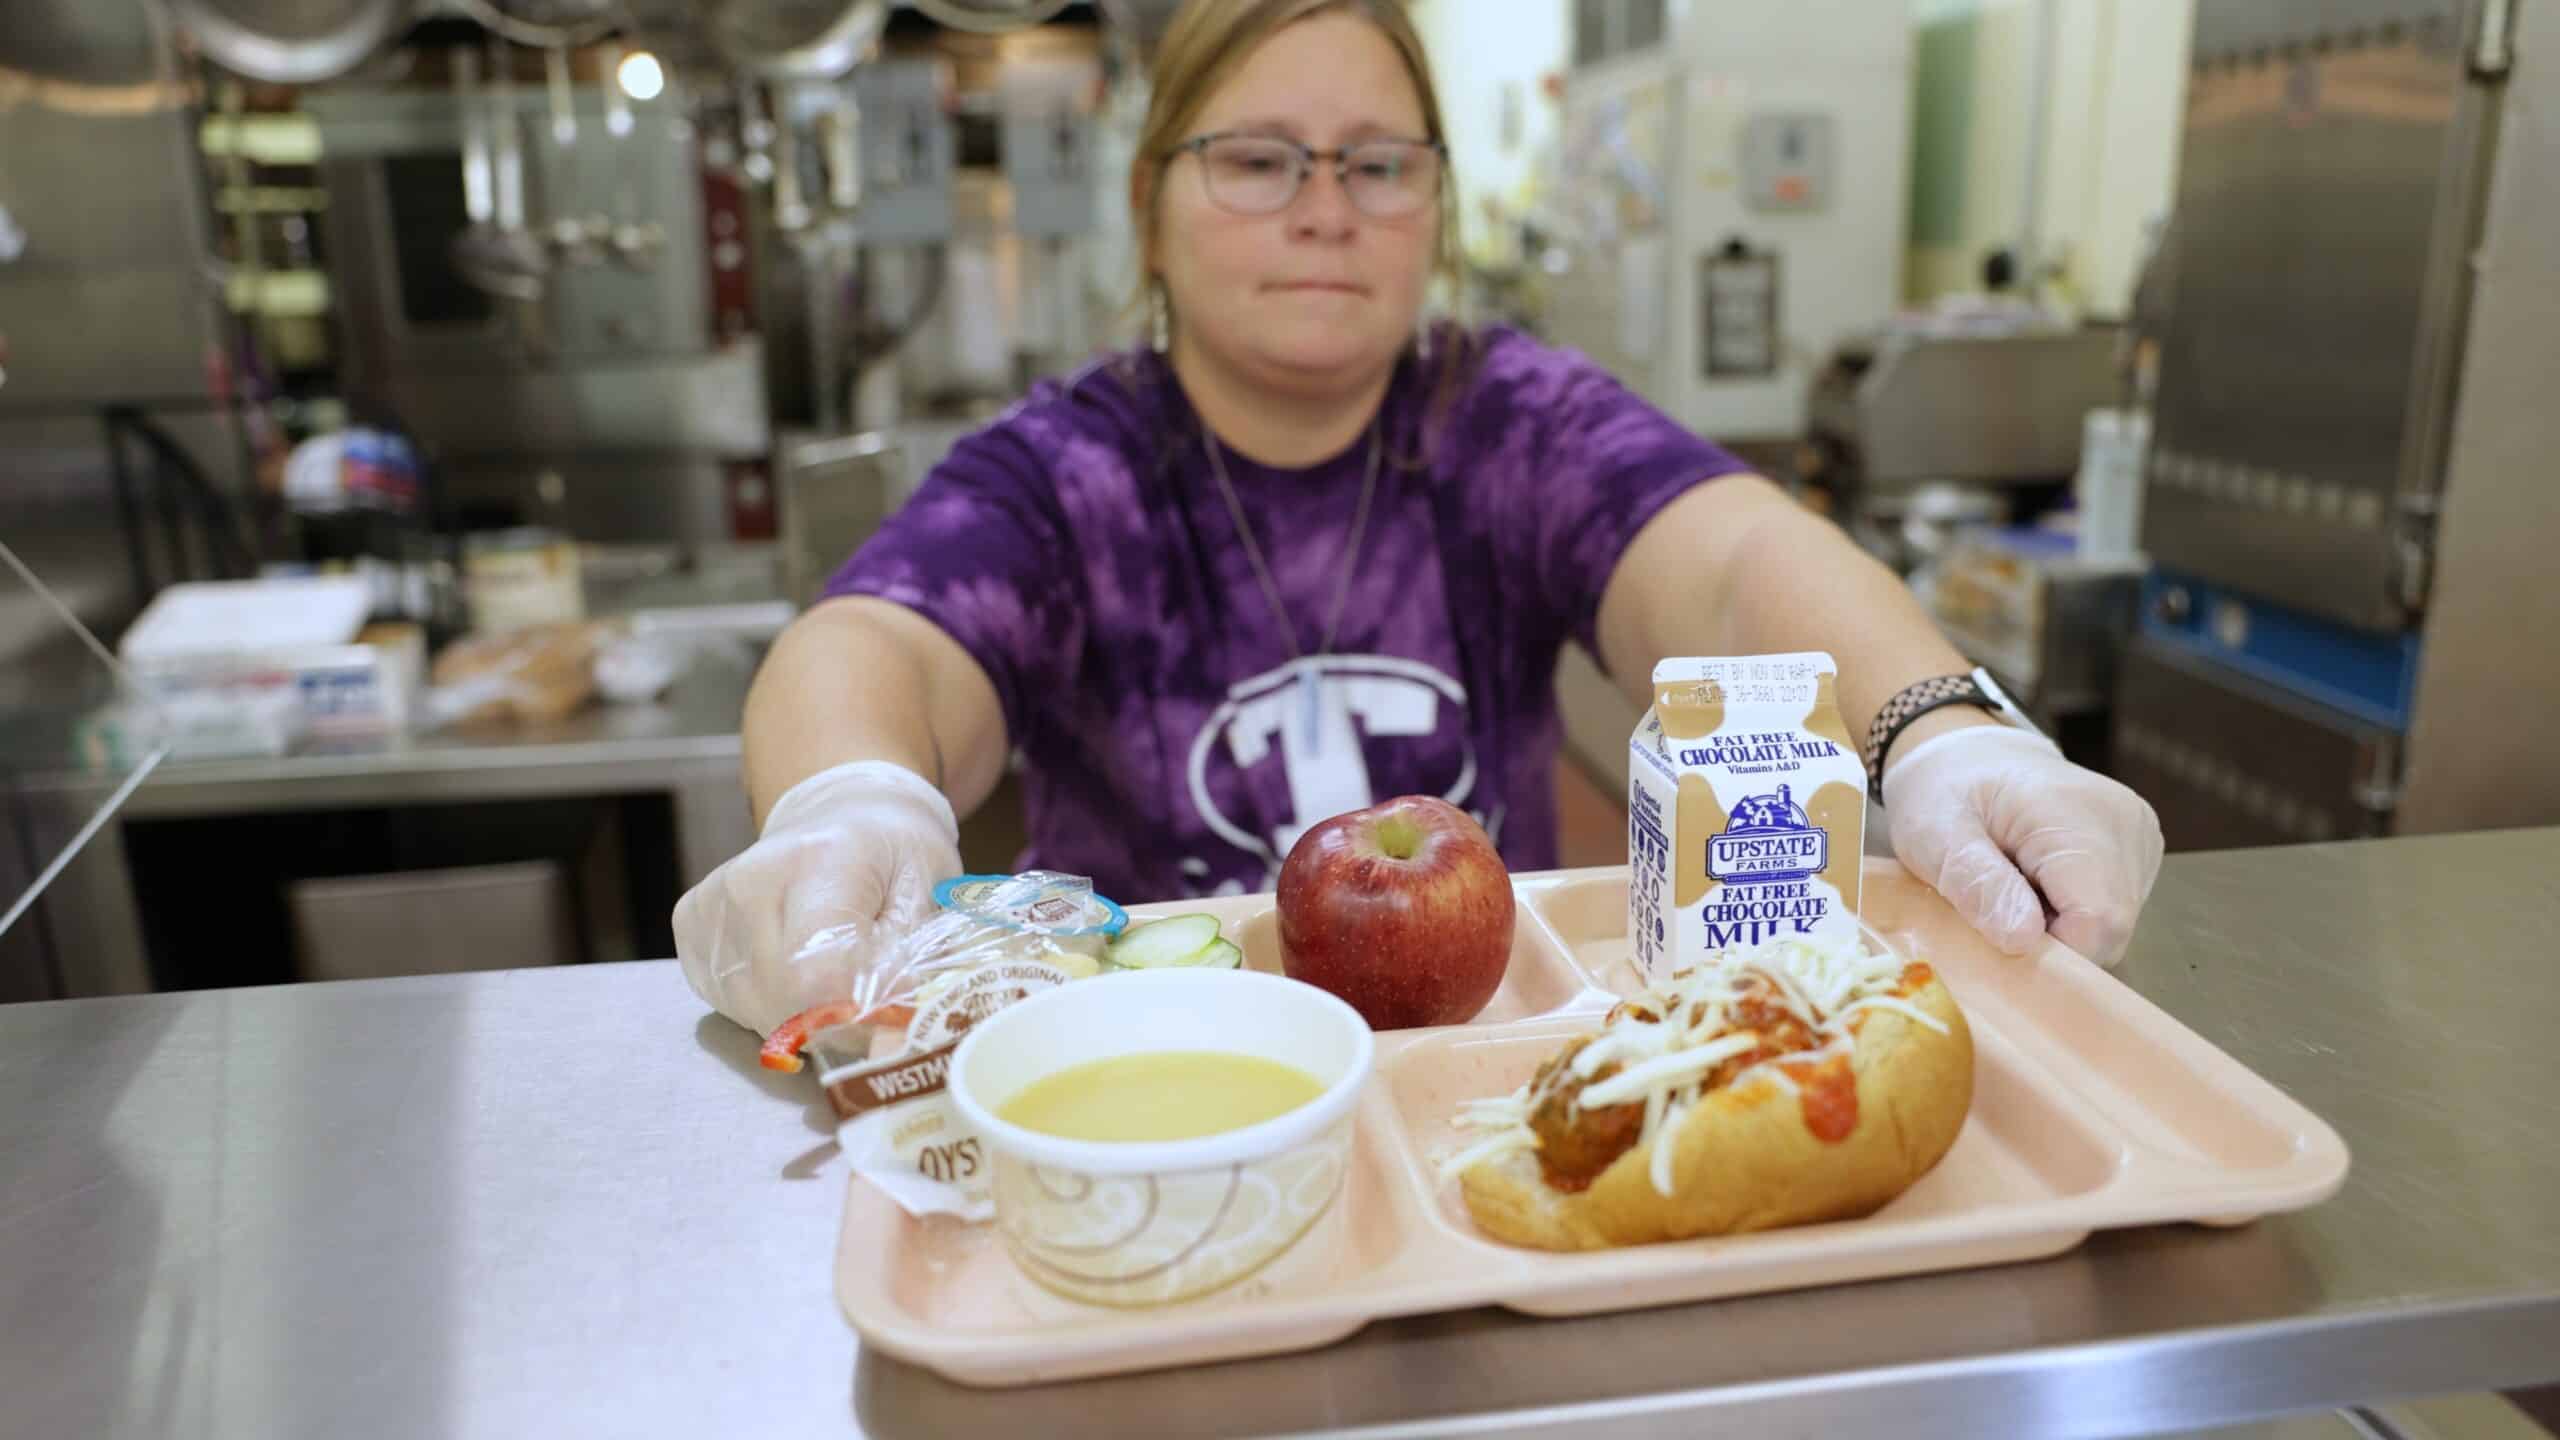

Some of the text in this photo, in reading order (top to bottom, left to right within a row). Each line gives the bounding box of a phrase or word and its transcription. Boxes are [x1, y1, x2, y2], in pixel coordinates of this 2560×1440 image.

[1712, 731, 1798, 747] FAT FREE
[1680, 743, 1787, 766] CHOCOLATE
[1790, 740, 1840, 759] MILK
[1728, 761, 1800, 775] Vitamins A&D
[1718, 836, 1816, 861] UPSTATE
[1736, 859, 1797, 871] FARMS
[1722, 883, 1810, 902] FAT FREE
[1702, 897, 1828, 922] CHOCOLATE
[920, 1136, 982, 1182] OYS
